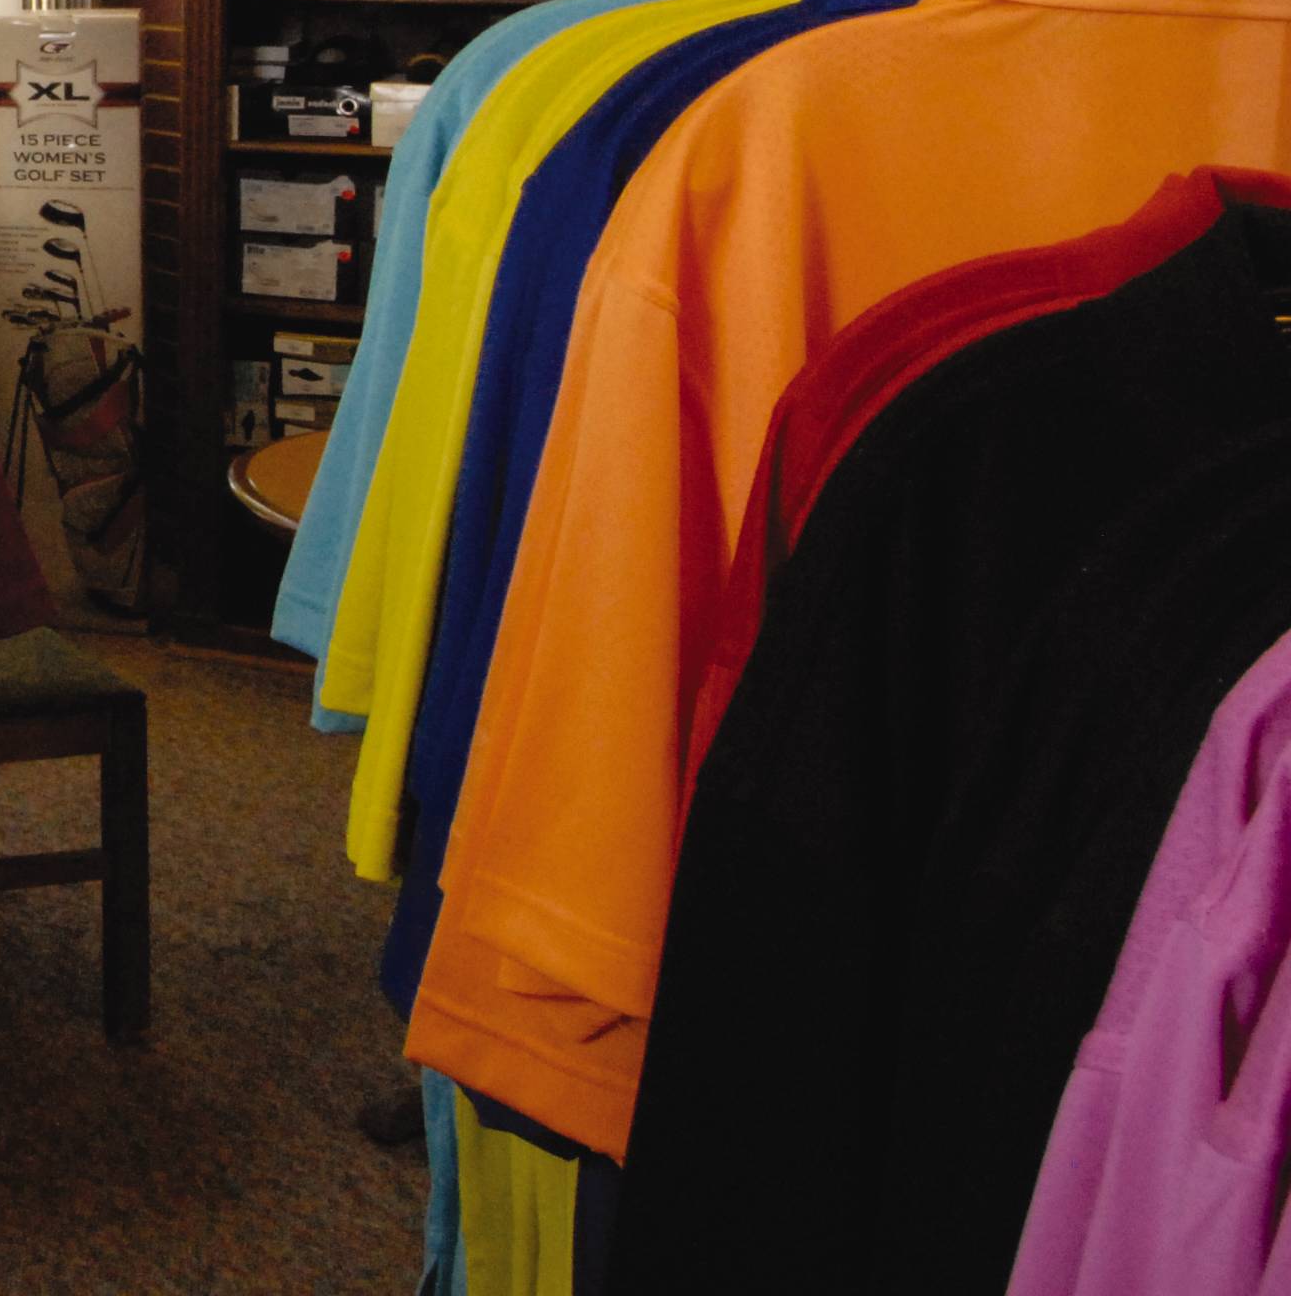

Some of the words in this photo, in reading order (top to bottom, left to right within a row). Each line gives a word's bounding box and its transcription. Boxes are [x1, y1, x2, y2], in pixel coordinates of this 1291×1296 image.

[27, 81, 91, 102] XL
[20, 133, 39, 146] 15
[43, 134, 102, 147] PIECE
[13, 151, 106, 165] WOMEN'S
[13, 169, 64, 182] GOLF
[70, 170, 106, 182] SET
